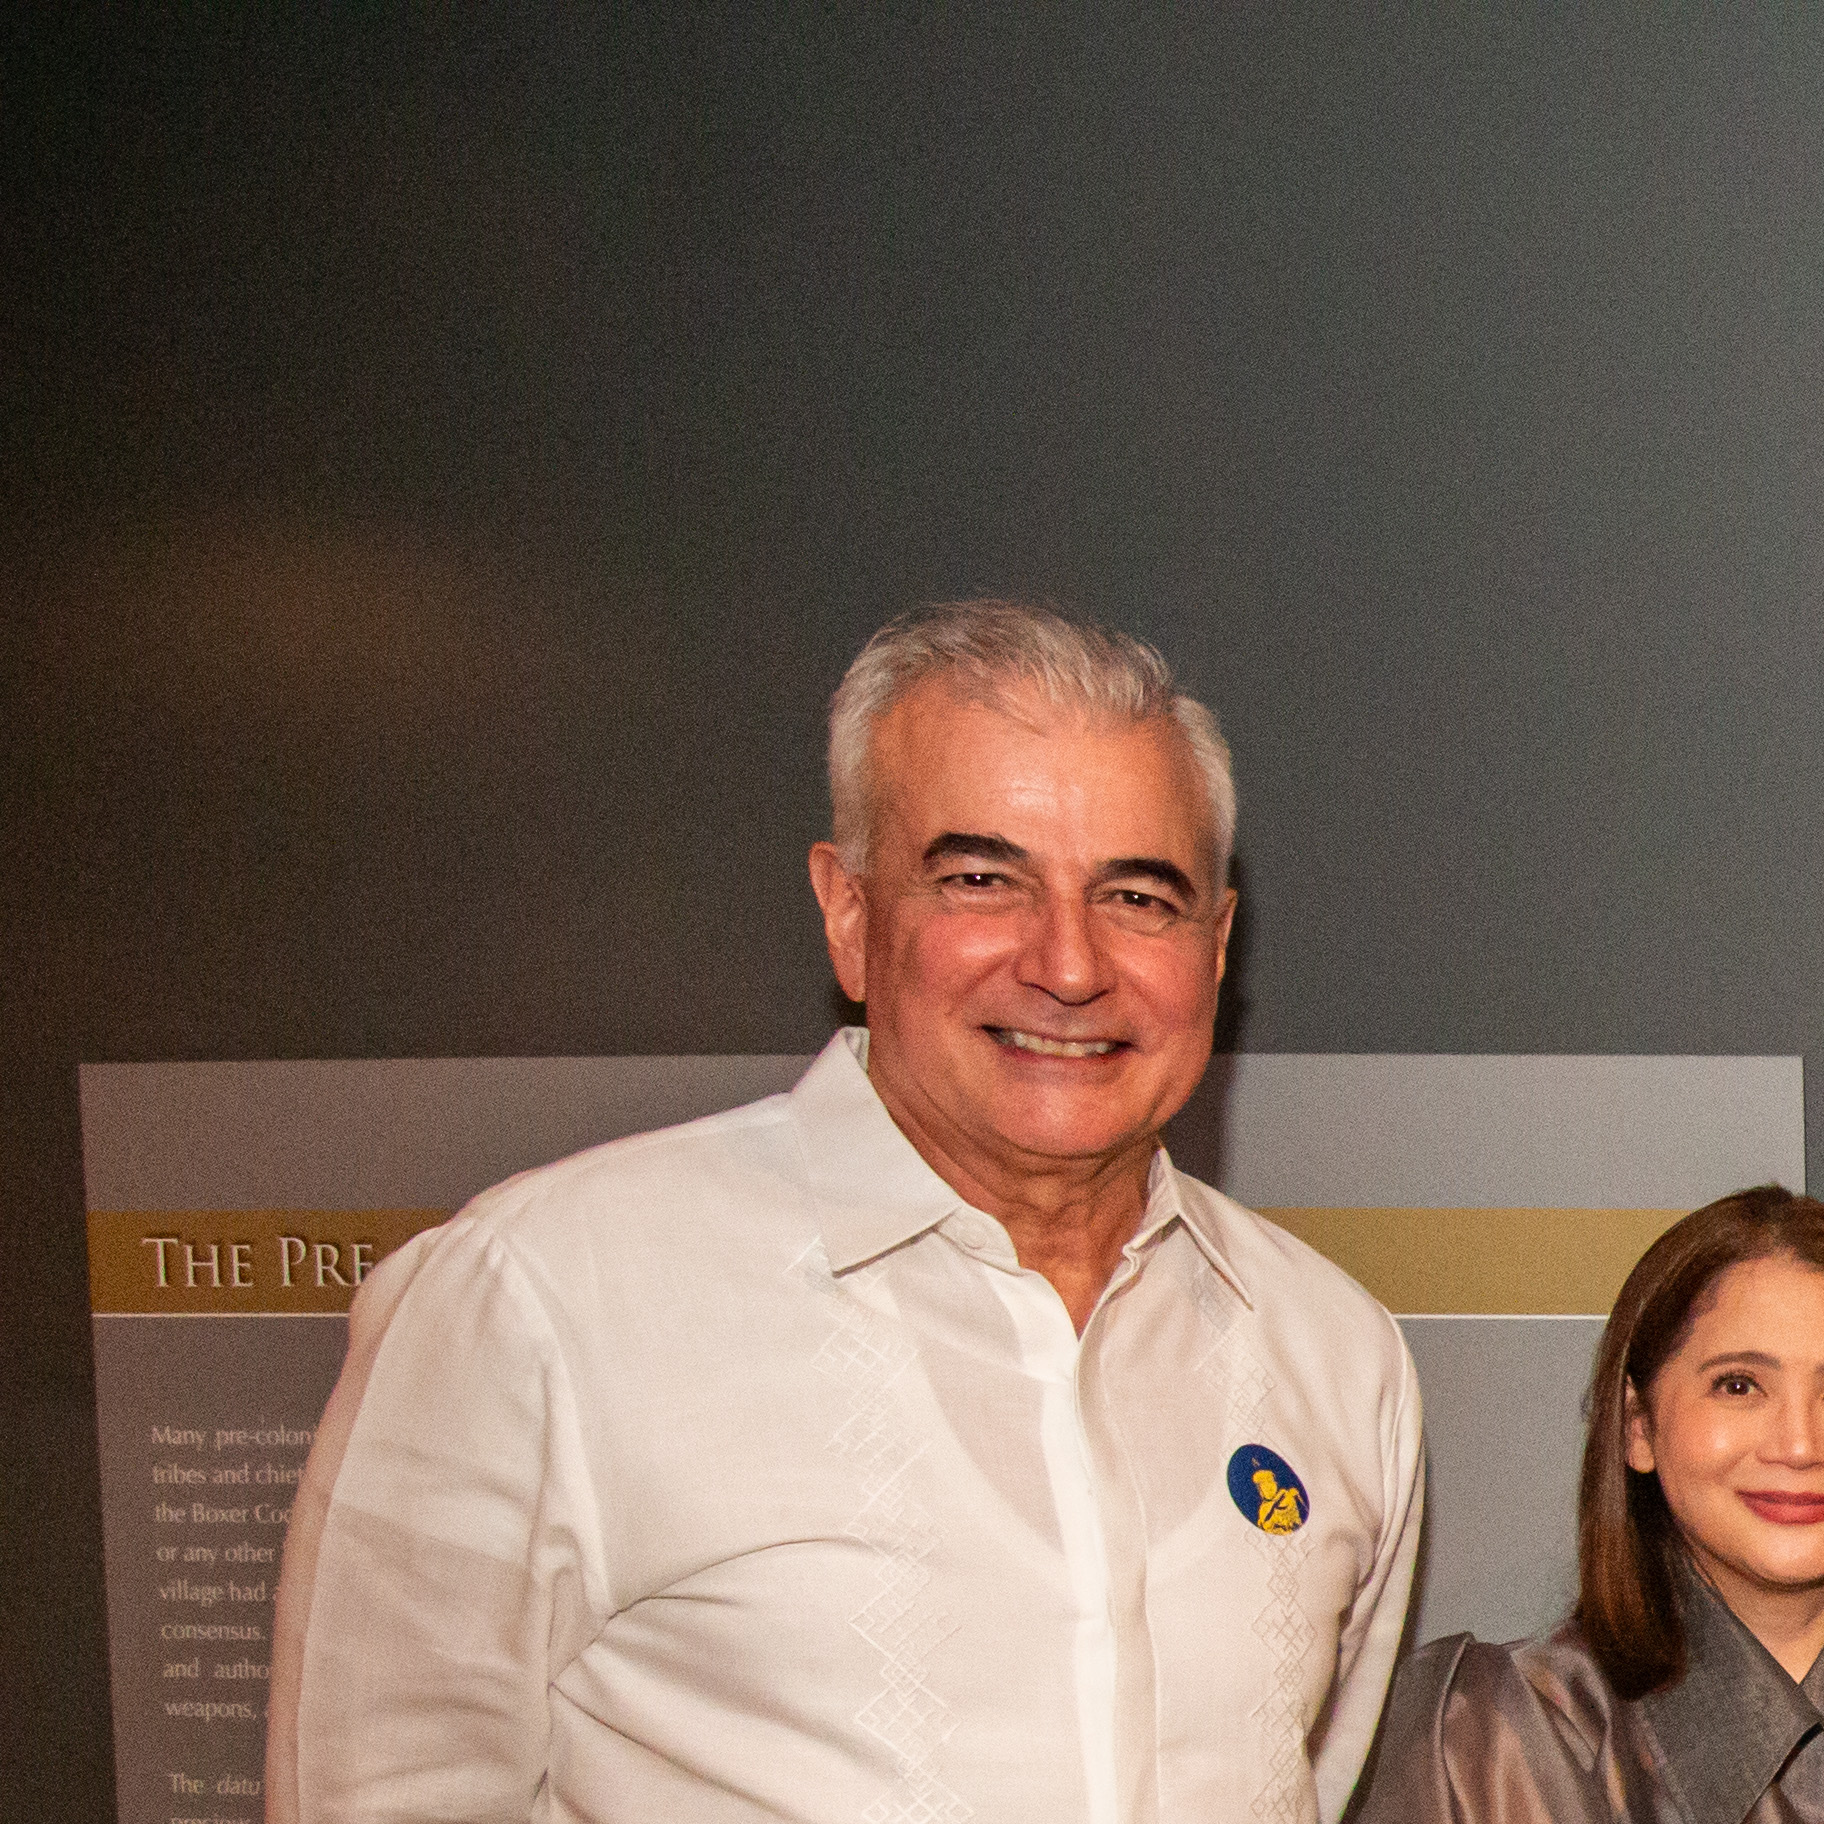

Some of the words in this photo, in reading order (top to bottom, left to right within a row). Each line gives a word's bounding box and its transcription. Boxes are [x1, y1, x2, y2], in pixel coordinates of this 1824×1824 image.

[141, 1237, 254, 1288] THE
[151, 1425, 206, 1450] Many
[152, 1462, 207, 1485] tribes
[211, 1462, 250, 1485] and
[155, 1501, 187, 1523] the
[192, 1502, 249, 1523] Boxer
[156, 1547, 177, 1562] or
[183, 1546, 217, 1566] any
[225, 1541, 276, 1563] other
[160, 1579, 224, 1608] village
[229, 1579, 266, 1601] had
[161, 1625, 268, 1640] consensus.
[162, 1657, 200, 1679] and
[167, 1772, 204, 1794] The
